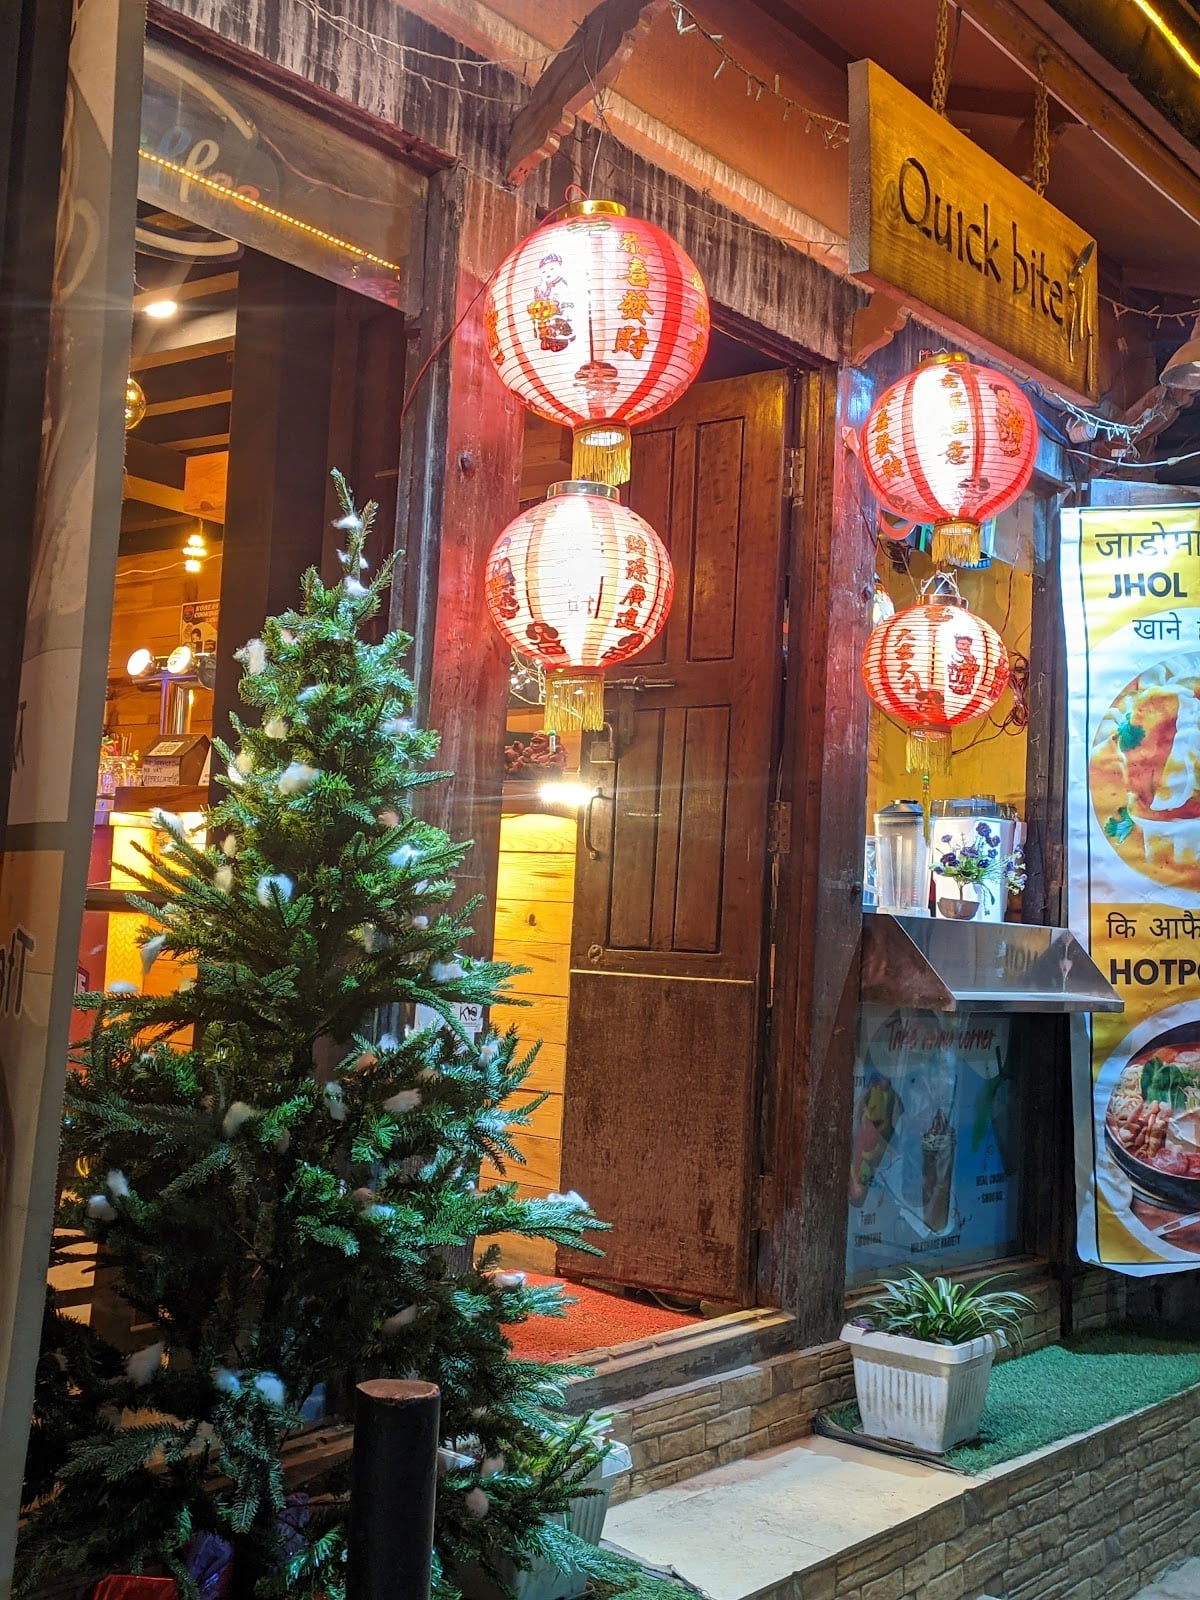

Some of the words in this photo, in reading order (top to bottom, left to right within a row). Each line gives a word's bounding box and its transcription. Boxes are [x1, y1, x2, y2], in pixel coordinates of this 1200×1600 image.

[899, 157, 1001, 283] Quick
[1012, 221, 1064, 326] bite
[1108, 571, 1188, 599] JHOL
[1132, 612, 1182, 640] खाने
[1106, 911, 1137, 938] कि
[1109, 958, 1200, 985] HOTP
